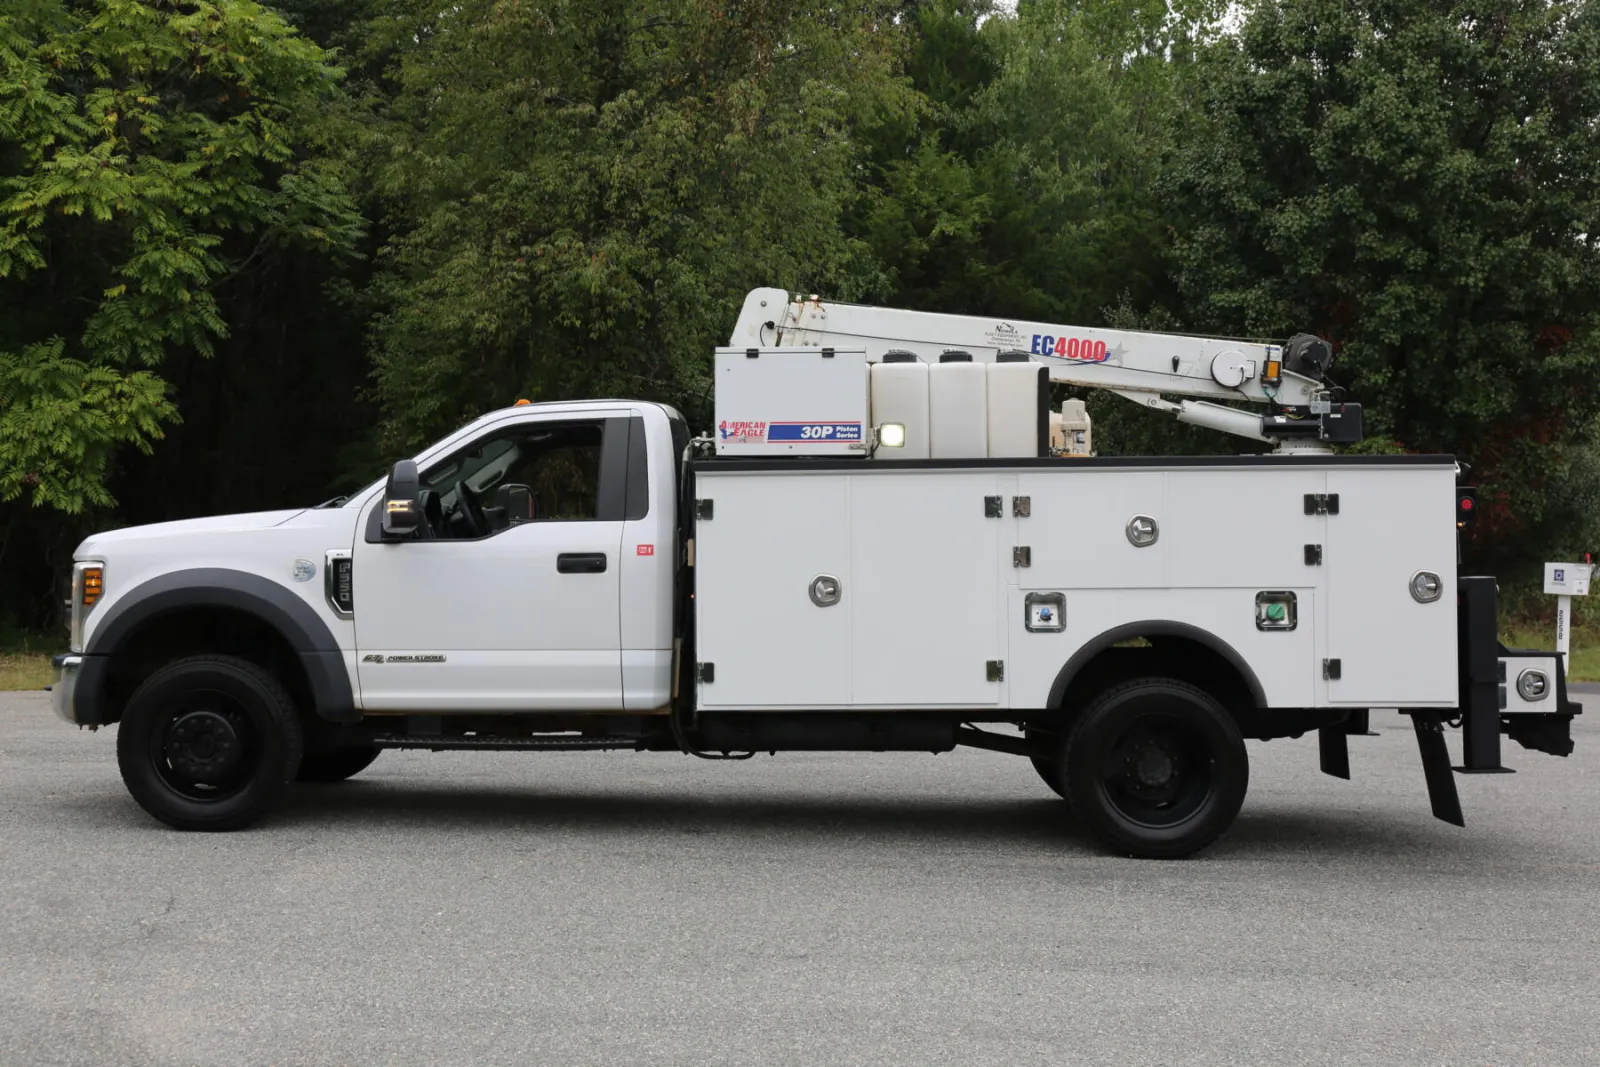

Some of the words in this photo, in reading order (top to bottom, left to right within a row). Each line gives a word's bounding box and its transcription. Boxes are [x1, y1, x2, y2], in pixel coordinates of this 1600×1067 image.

[1031, 334, 1106, 361] EC4000
[719, 420, 766, 429] AMERICAN
[733, 428, 765, 437] EAGLE
[801, 425, 834, 439] 30P
